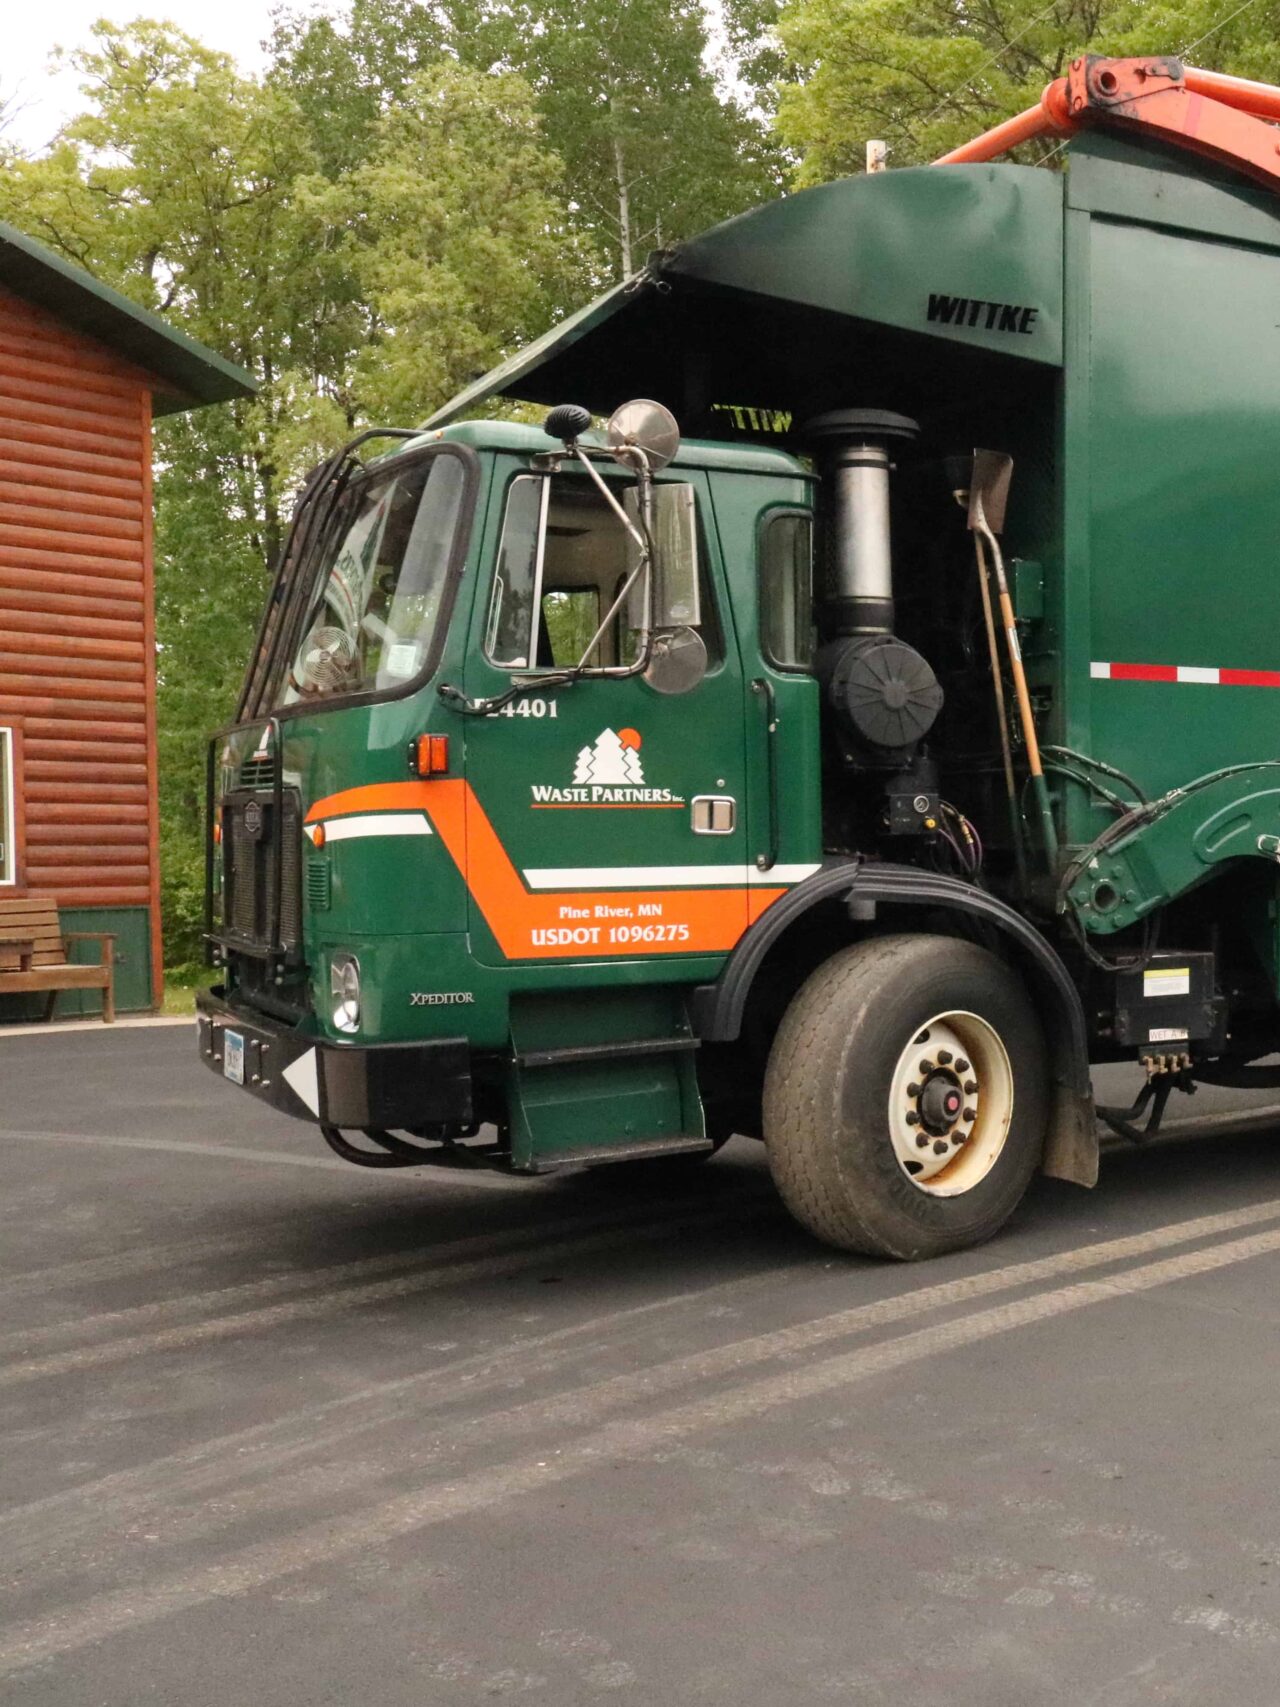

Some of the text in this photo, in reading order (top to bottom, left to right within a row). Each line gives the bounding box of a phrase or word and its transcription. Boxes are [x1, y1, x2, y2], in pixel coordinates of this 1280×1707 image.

[926, 293, 1039, 335] WITTKE
[530, 785, 589, 802] WASTE
[591, 785, 671, 802] PARTNERS
[559, 903, 663, 919] Pine River, MN
[531, 924, 690, 946] USDOT 1096275
[409, 991, 476, 1006] XPEDITOR
